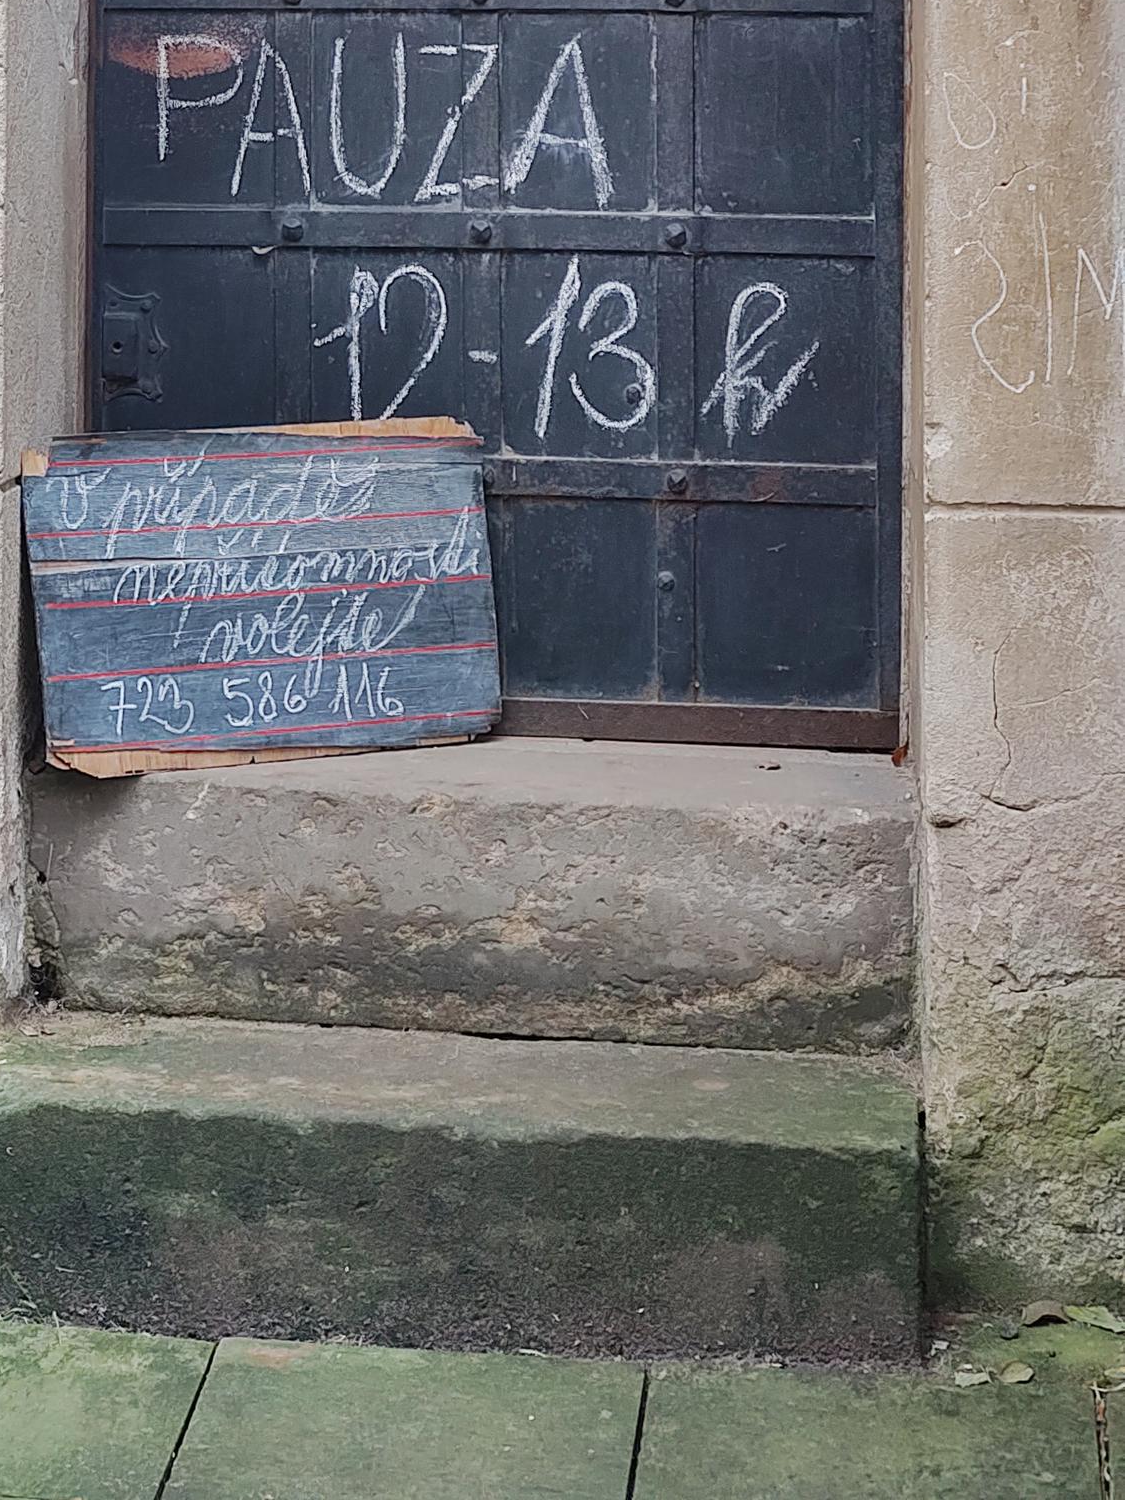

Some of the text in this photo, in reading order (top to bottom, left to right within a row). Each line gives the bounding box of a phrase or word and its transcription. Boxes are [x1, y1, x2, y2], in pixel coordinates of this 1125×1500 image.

[154, 31, 616, 210] PAUZA
[525, 253, 657, 440] 13
[101, 662, 405, 737] 723 586 116
